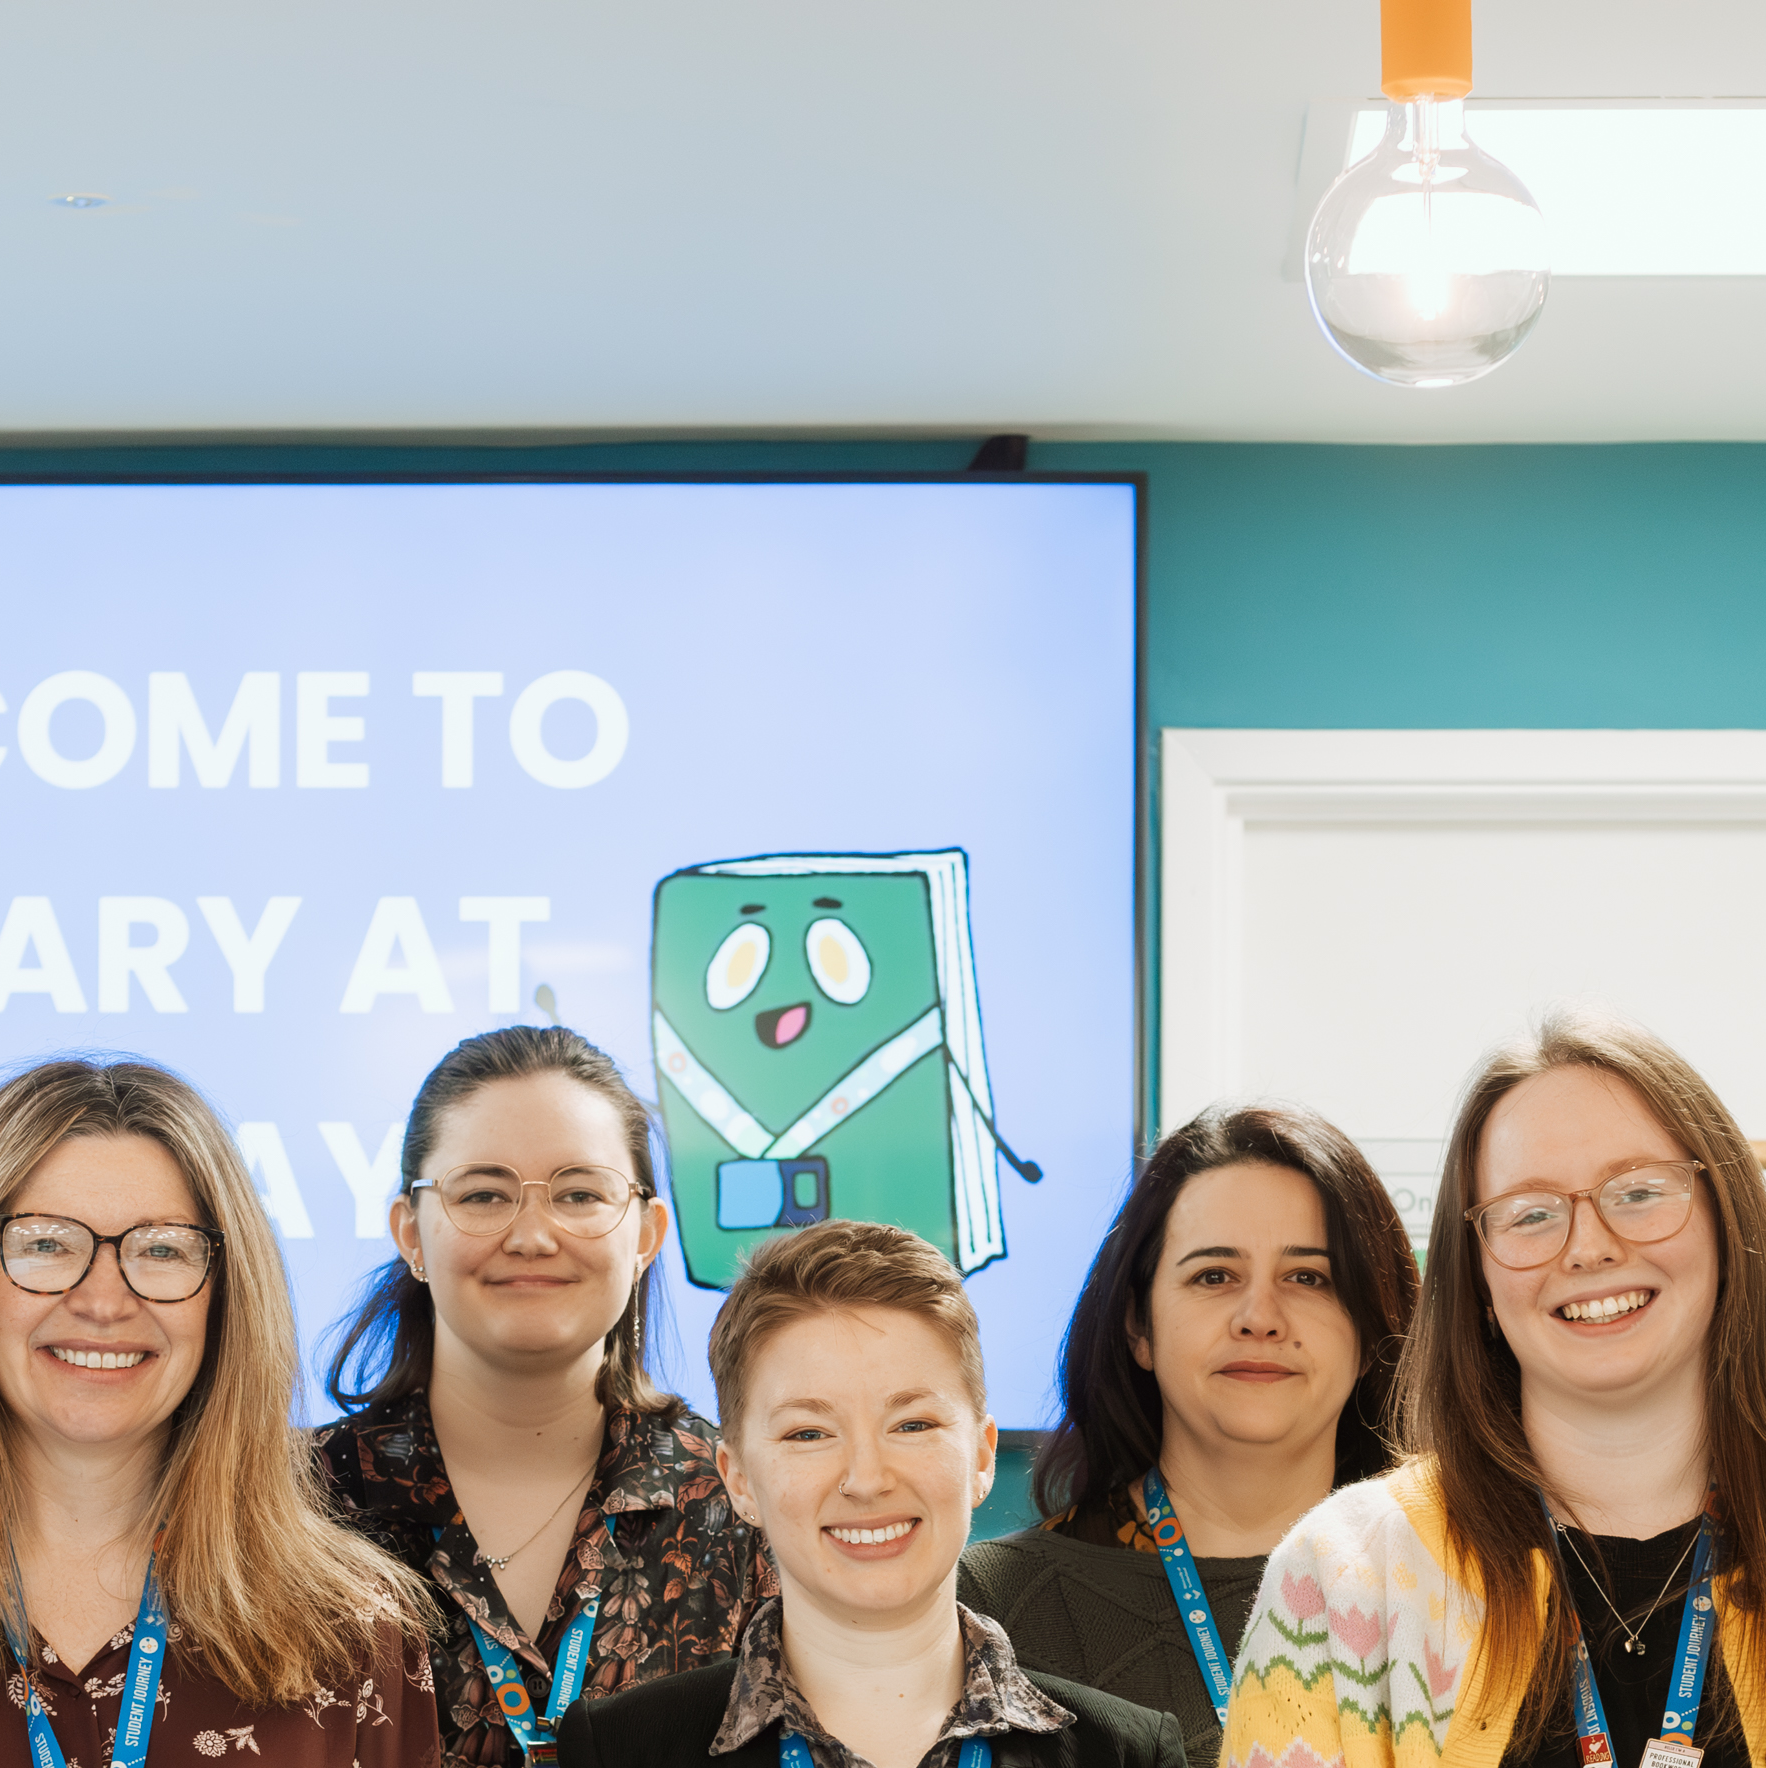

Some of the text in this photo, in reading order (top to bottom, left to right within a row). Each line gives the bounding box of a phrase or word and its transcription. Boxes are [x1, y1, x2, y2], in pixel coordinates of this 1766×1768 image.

[413, 671, 629, 791] TO
[340, 895, 551, 1015] AT
[557, 1628, 583, 1717] STUDENT JOURNEY
[1196, 1627, 1231, 1696] STUDENT JOURNEY
[1678, 1614, 1706, 1698] STUDENT JOURNEY
[124, 1656, 153, 1747] STUDENT JOURNEY
[1649, 1752, 1694, 1767] PROFESSIONAL
